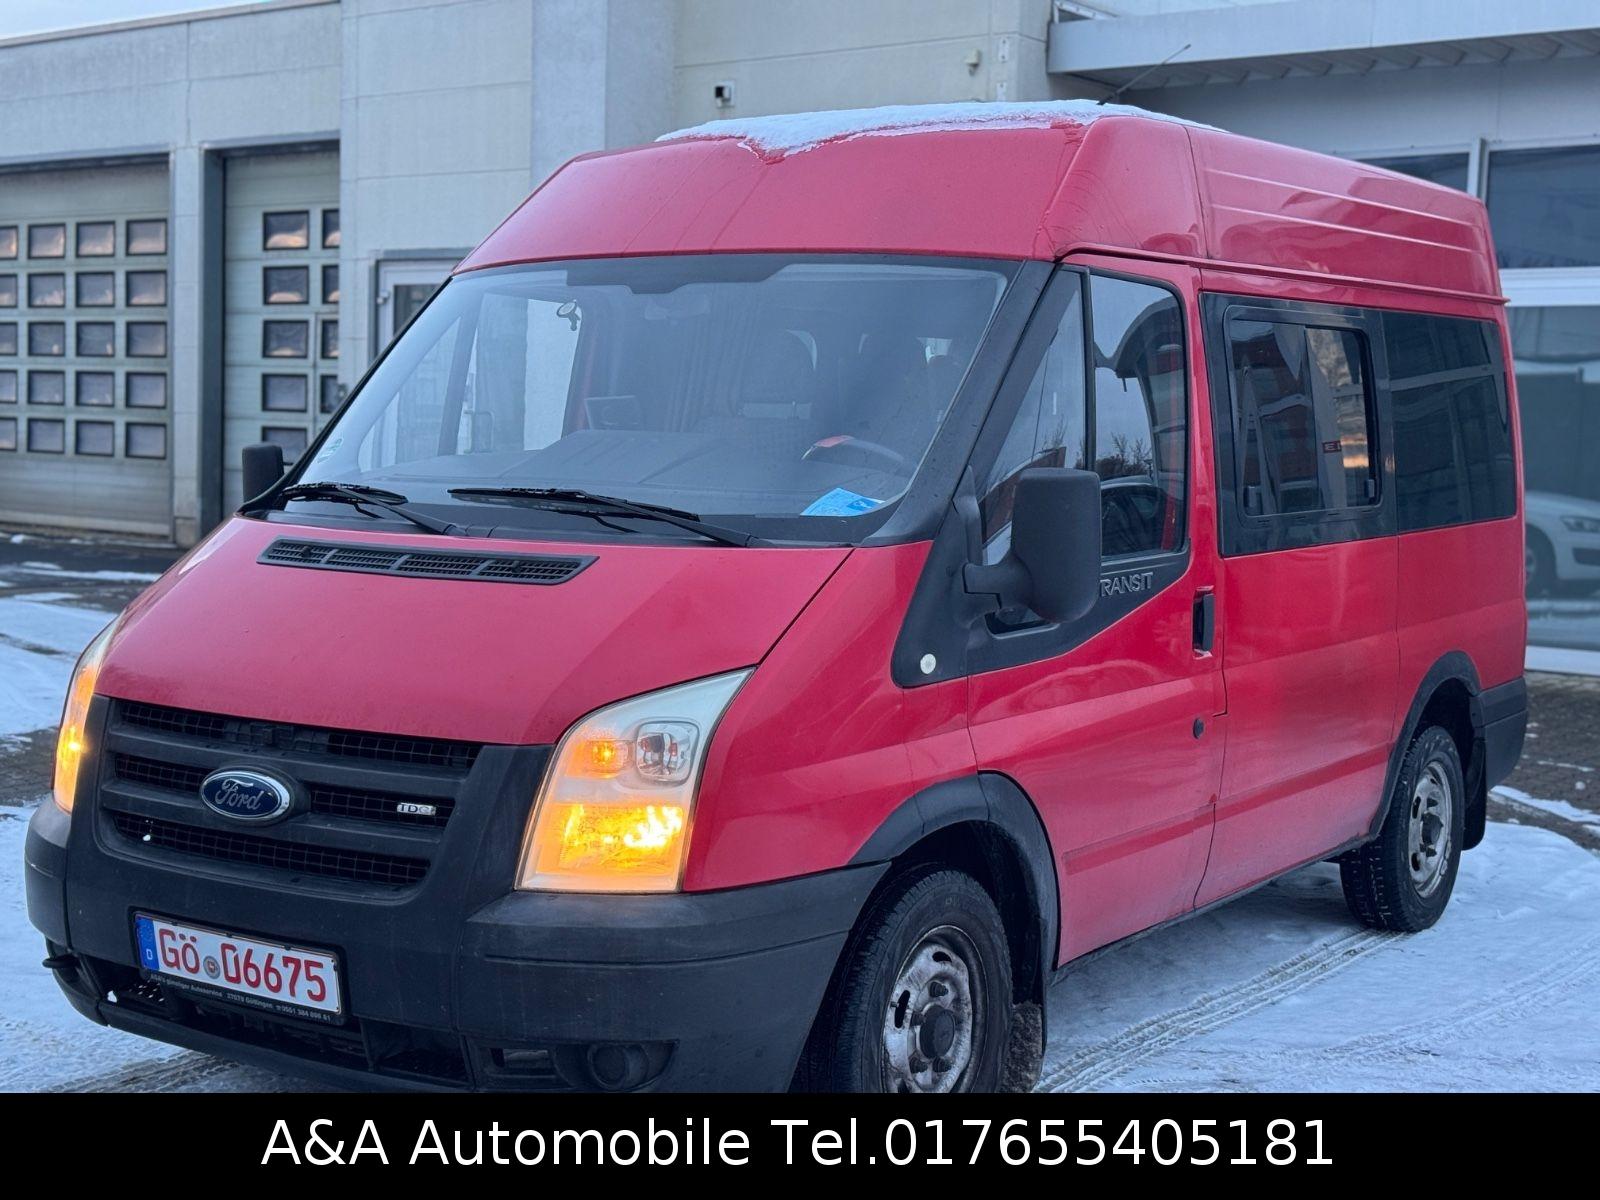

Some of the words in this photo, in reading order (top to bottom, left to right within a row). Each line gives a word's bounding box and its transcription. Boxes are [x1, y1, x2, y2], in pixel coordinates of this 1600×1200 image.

[1099, 571, 1153, 597] RANSIT
[214, 778, 264, 810] Ford
[145, 948, 153, 960] D
[158, 928, 200, 974] GÖ
